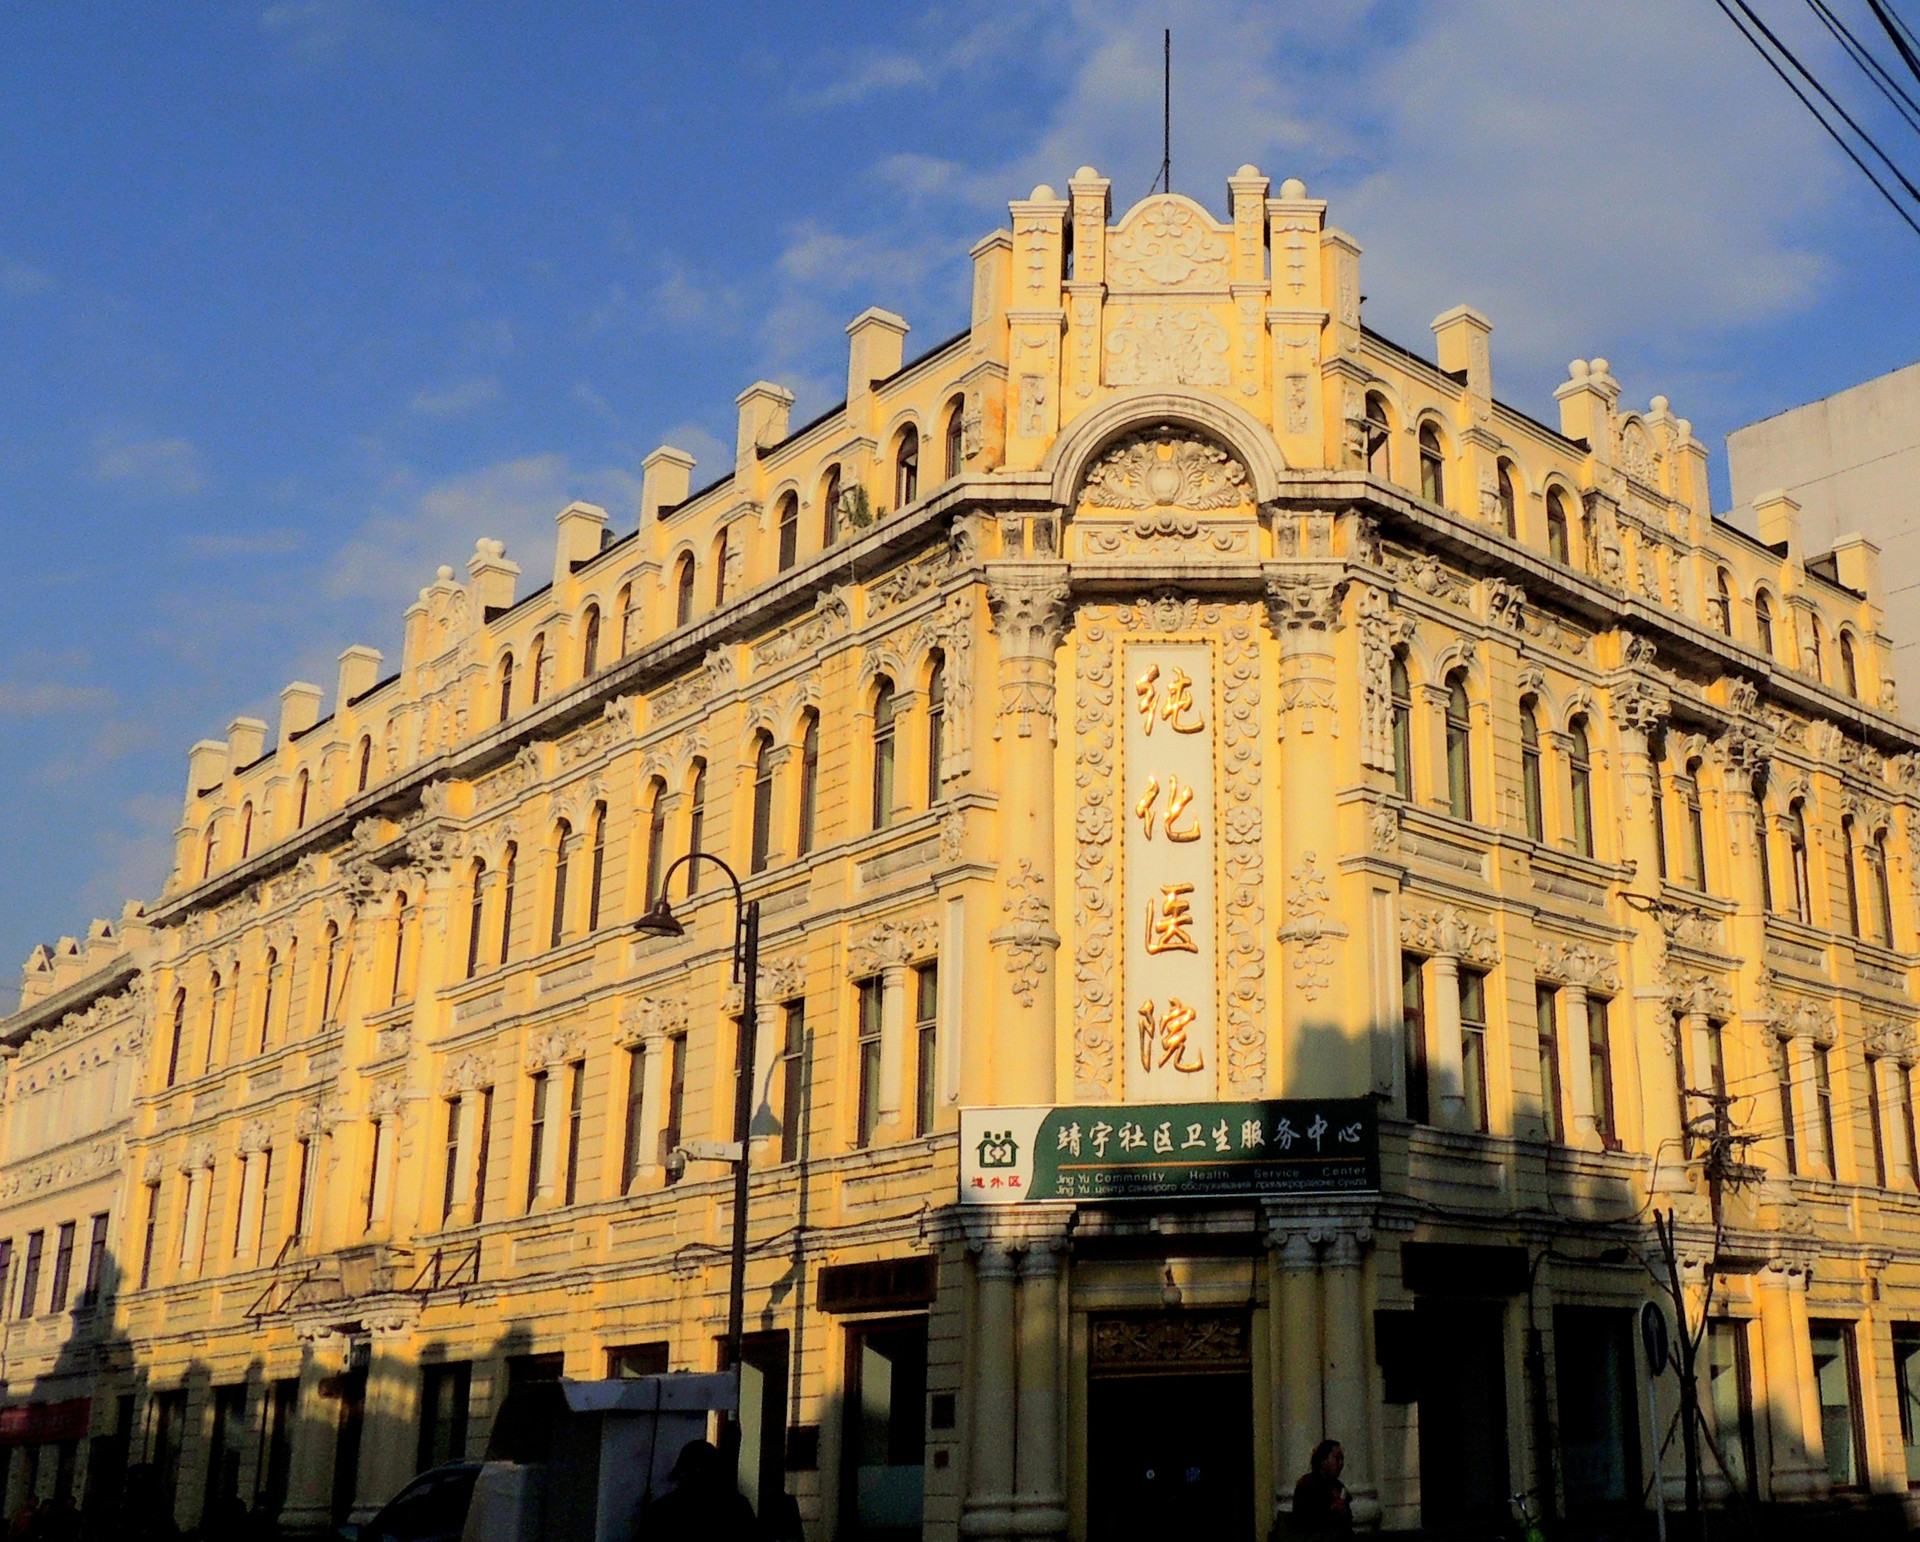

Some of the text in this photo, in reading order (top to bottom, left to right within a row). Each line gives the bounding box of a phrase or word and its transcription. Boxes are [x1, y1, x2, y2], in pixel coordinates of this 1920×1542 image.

[1135, 663, 1205, 1074] 纯化医院
[1057, 1114, 1363, 1157] 靖宇社区卫生服务中心
[971, 1176, 1022, 1188] 道外区
[1056, 1175, 1075, 1185] Jing
[1078, 1174, 1090, 1183] Yu
[1190, 1170, 1229, 1179] Health
[1254, 1168, 1299, 1178] Service
[1322, 1166, 1366, 1176] Center
[1056, 1185, 1075, 1196] Jing
[1078, 1184, 1090, 1194] Yu
